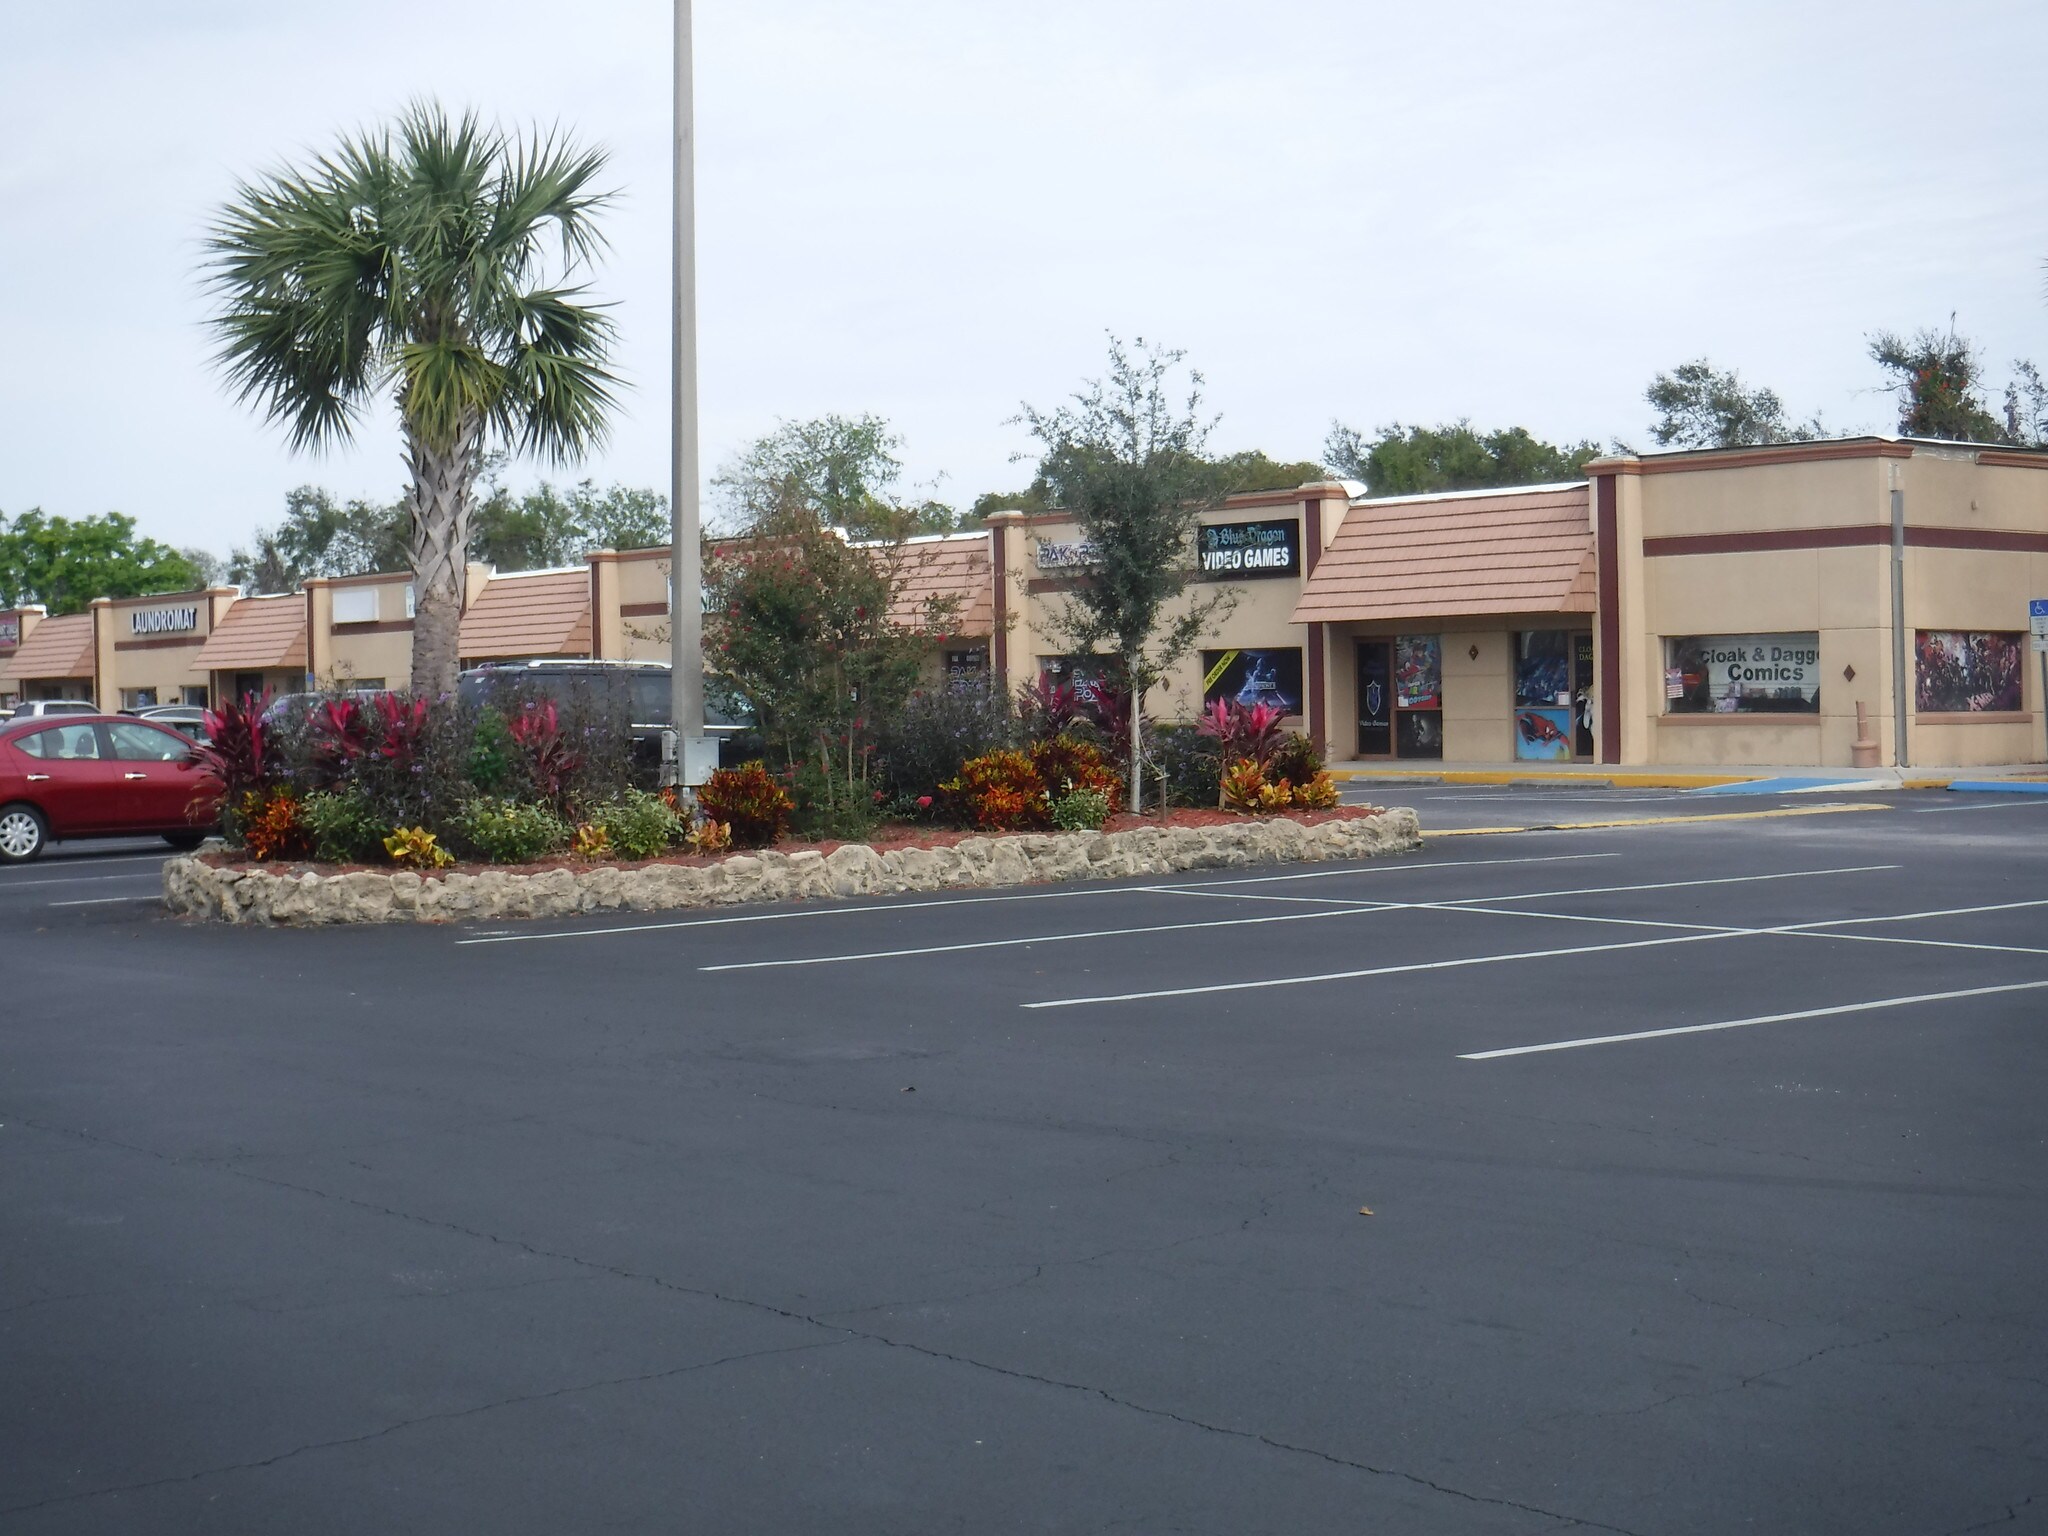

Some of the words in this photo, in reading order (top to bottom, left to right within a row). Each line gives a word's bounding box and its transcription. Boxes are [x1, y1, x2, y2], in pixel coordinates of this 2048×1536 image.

[1247, 527, 1285, 545] Dragon
[1202, 551, 1242, 571] VIDEO
[1244, 547, 1290, 568] GAMES
[132, 608, 197, 634] LAUNDROMAT
[1701, 648, 1747, 663] Cloak
[1752, 648, 1766, 662] &
[1728, 663, 1804, 681] Comics
